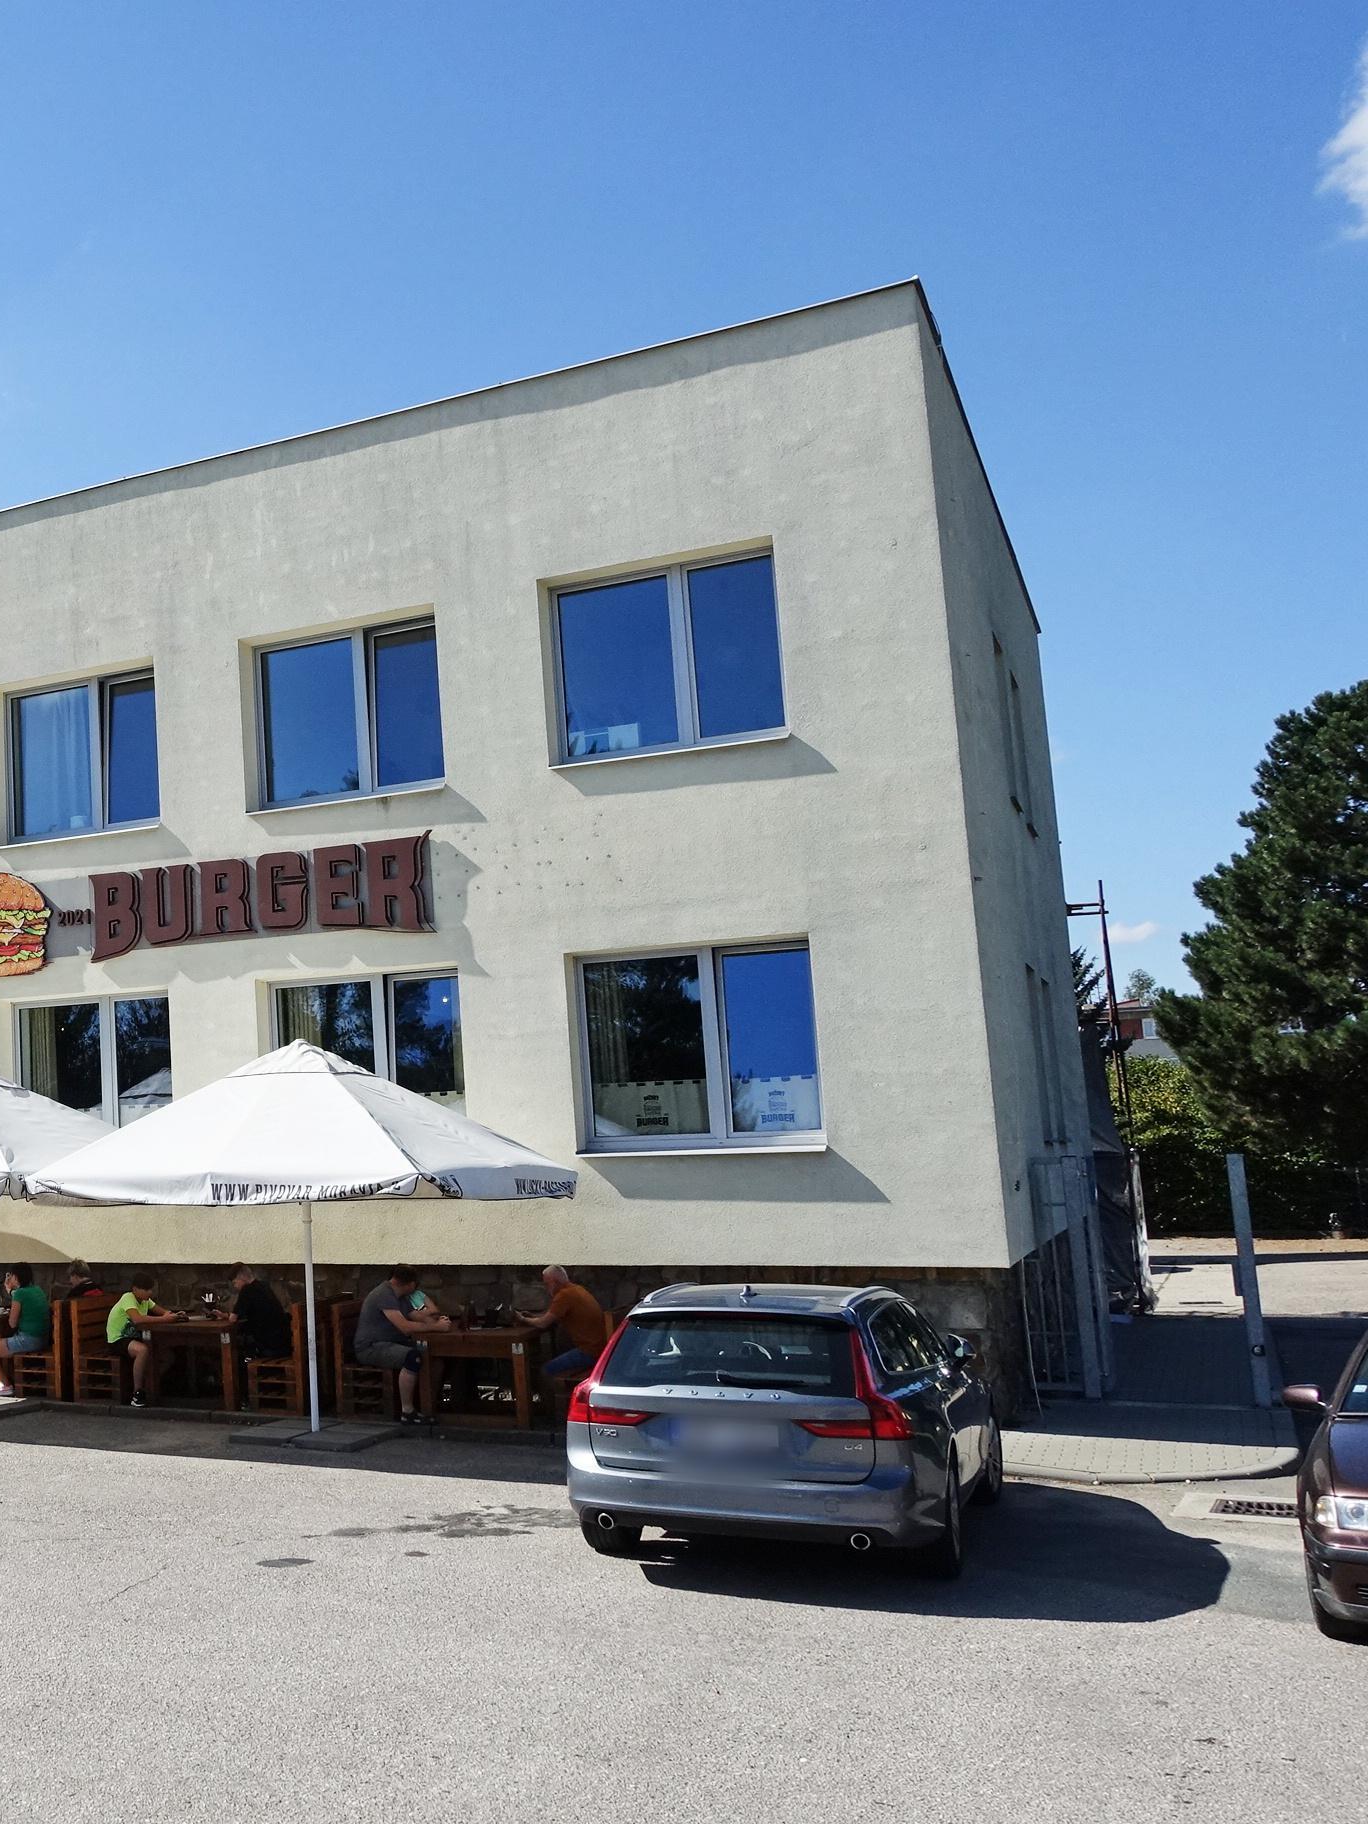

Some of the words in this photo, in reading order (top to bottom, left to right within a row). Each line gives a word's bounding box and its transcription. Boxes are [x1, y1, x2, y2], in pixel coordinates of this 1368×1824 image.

[58, 908, 92, 928] 2021
[89, 829, 438, 963] BURGER
[211, 1180, 401, 1201] WWW.PIVOVAR-MORAVIAZ
[662, 1387, 782, 1400] VOLVO
